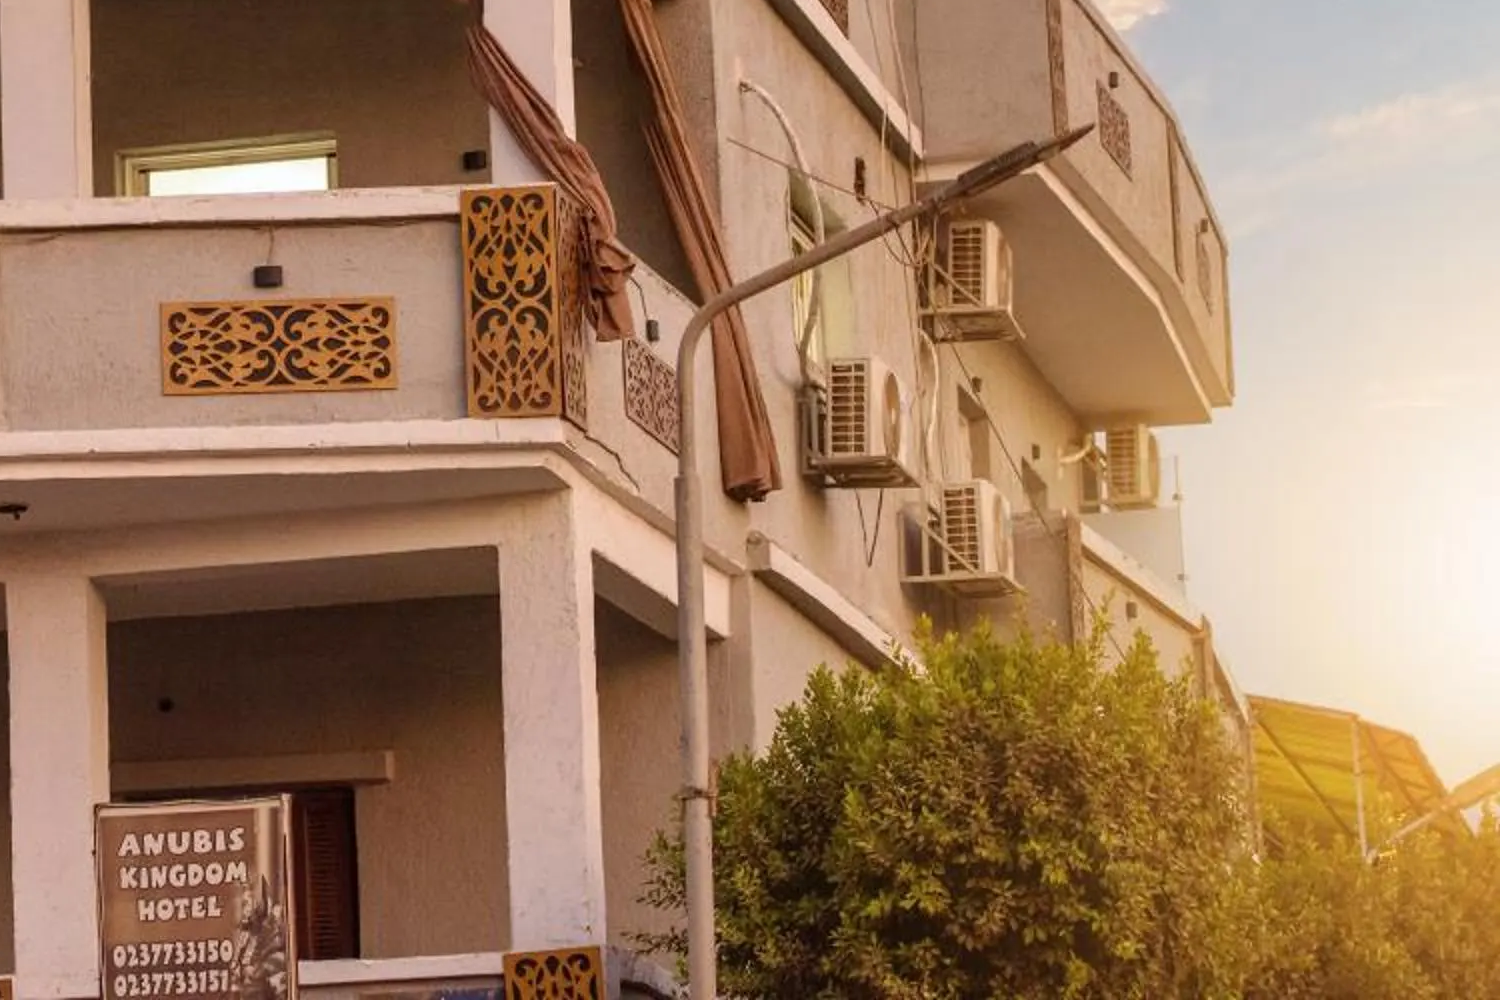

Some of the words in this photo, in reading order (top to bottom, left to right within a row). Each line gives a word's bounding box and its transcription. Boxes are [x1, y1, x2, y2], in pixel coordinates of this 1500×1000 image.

[118, 828, 244, 857] ANUBIS
[120, 861, 246, 889] KINGDOM
[138, 896, 222, 921] HOTEL
[113, 939, 233, 968] 0237733150
[114, 969, 229, 998] 0237733151
